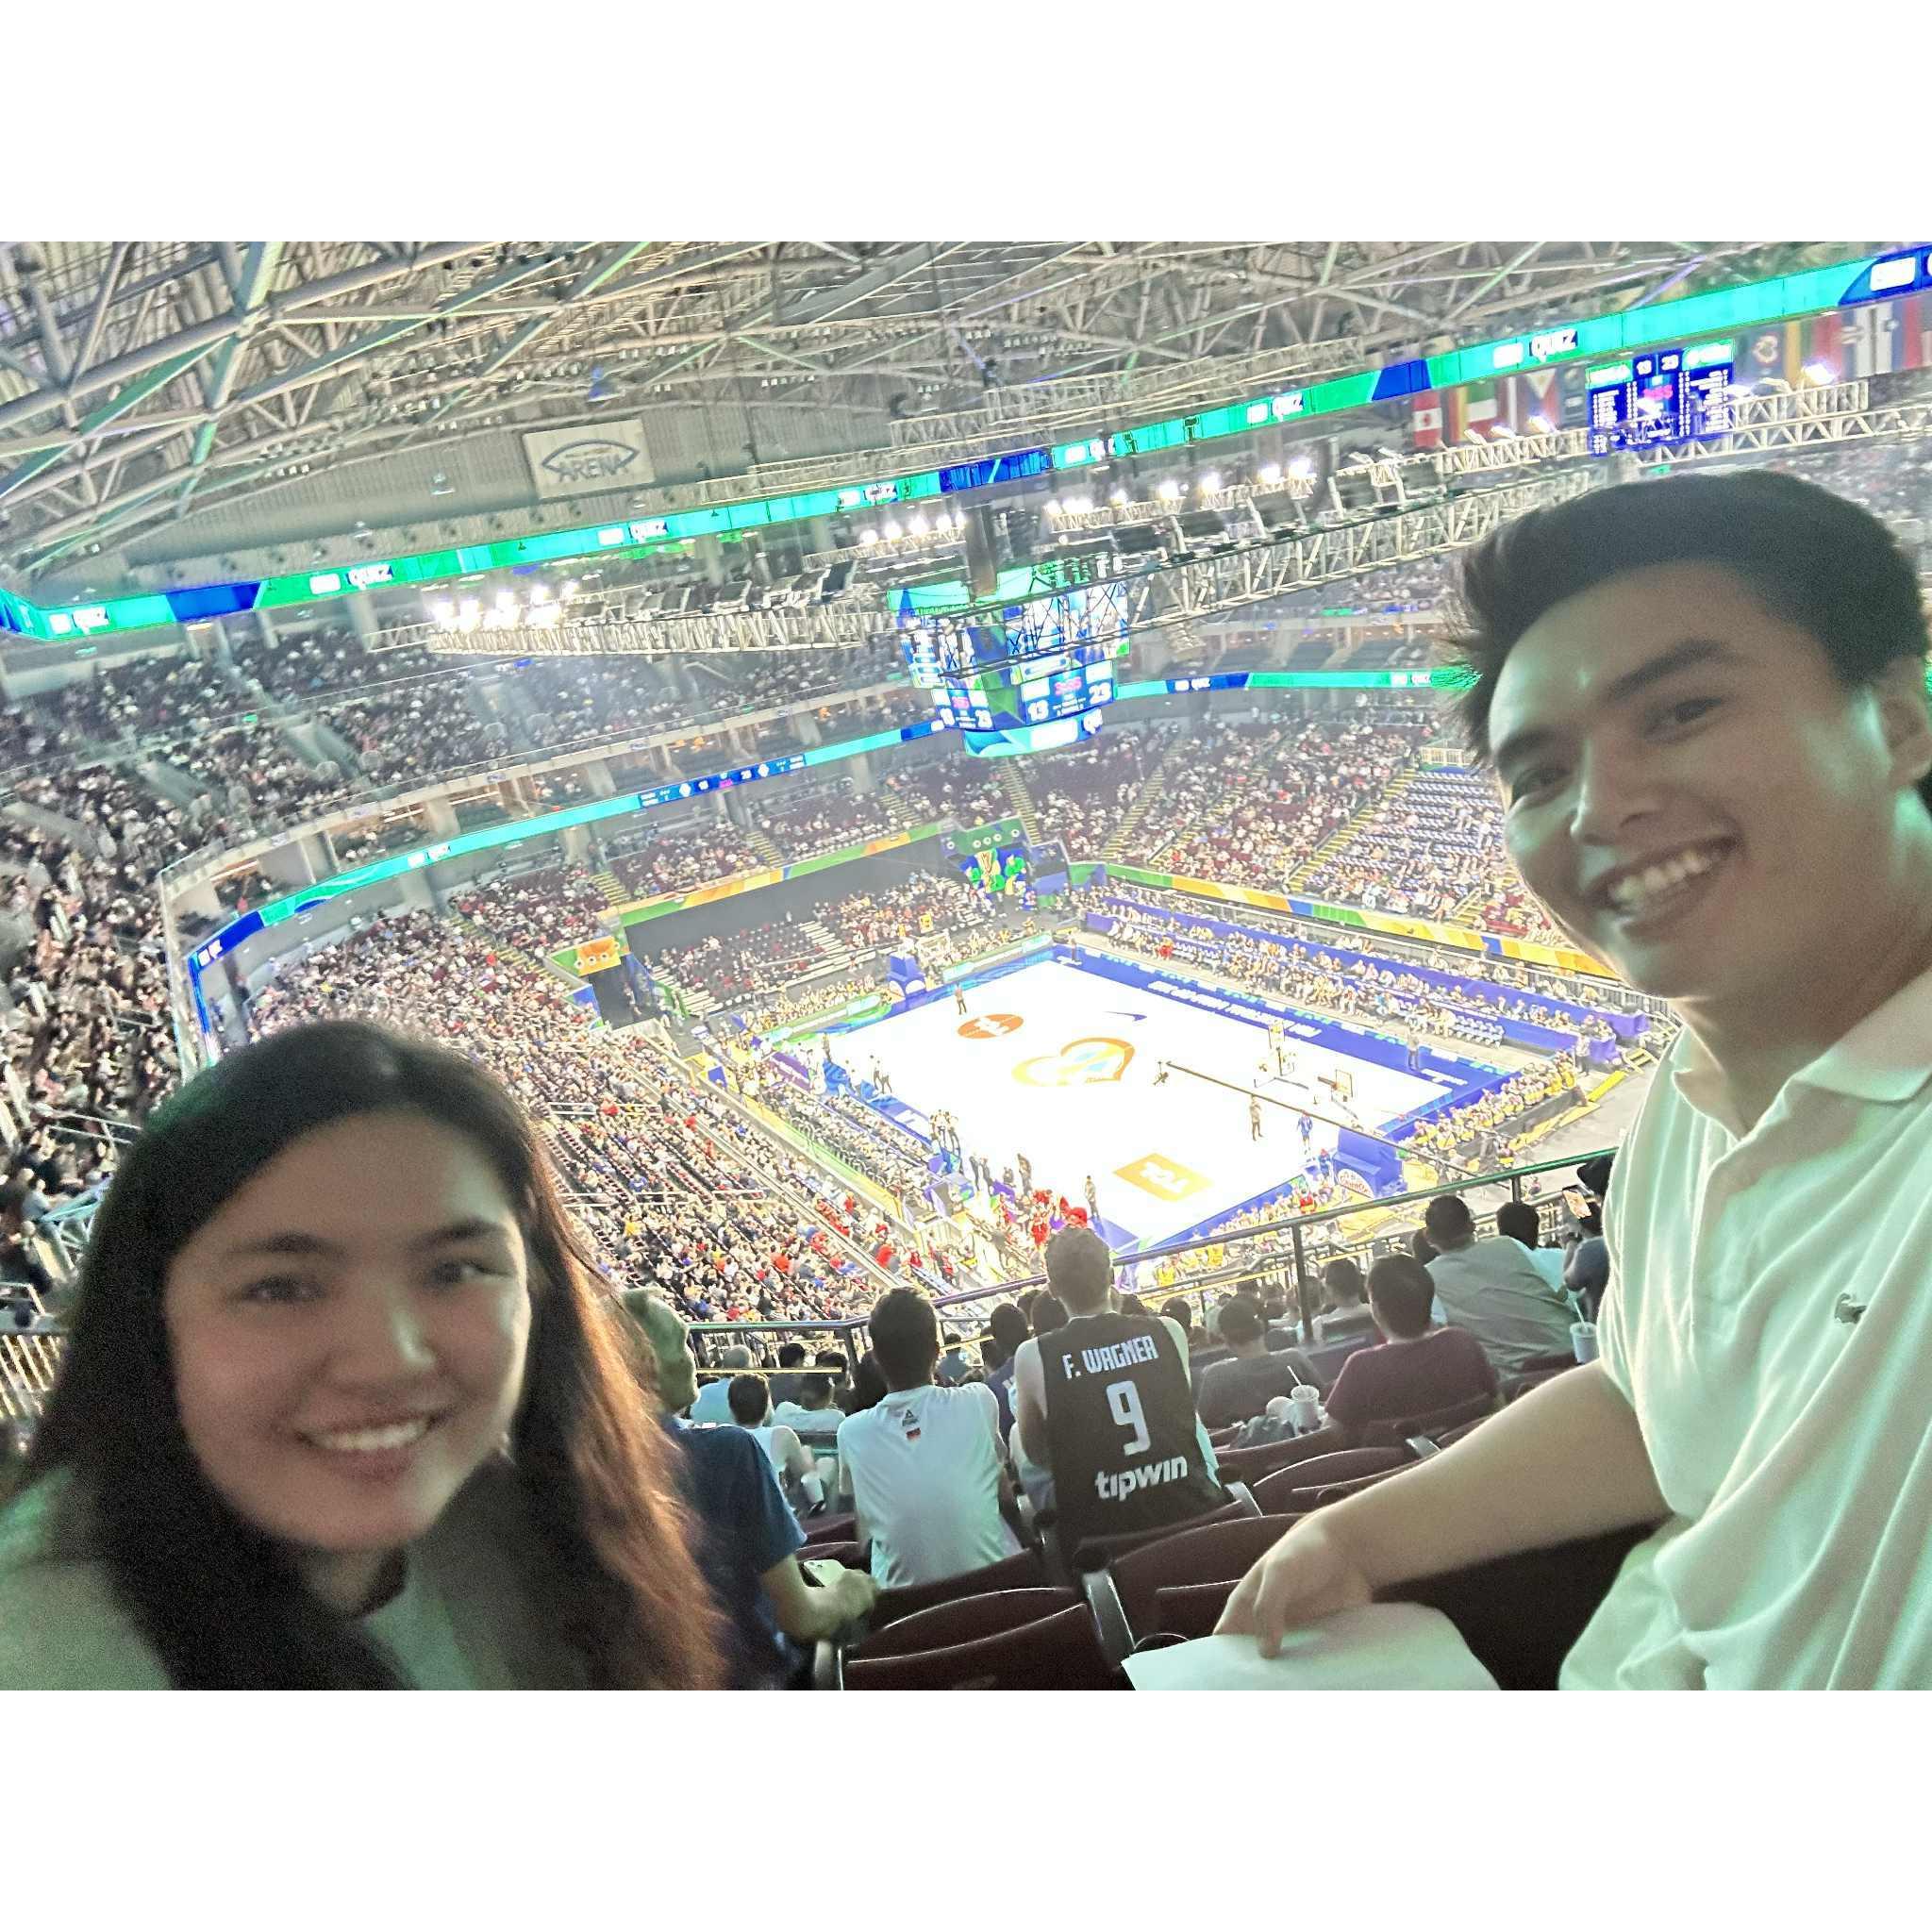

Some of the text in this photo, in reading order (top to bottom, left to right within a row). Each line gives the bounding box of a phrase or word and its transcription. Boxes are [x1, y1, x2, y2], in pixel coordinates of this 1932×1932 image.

[1531, 328, 1576, 362] QUIZ
[1062, 1335, 1160, 1380] F. WAGNER
[1106, 1380, 1151, 1457] 9
[1094, 1456, 1189, 1502] tipwin
